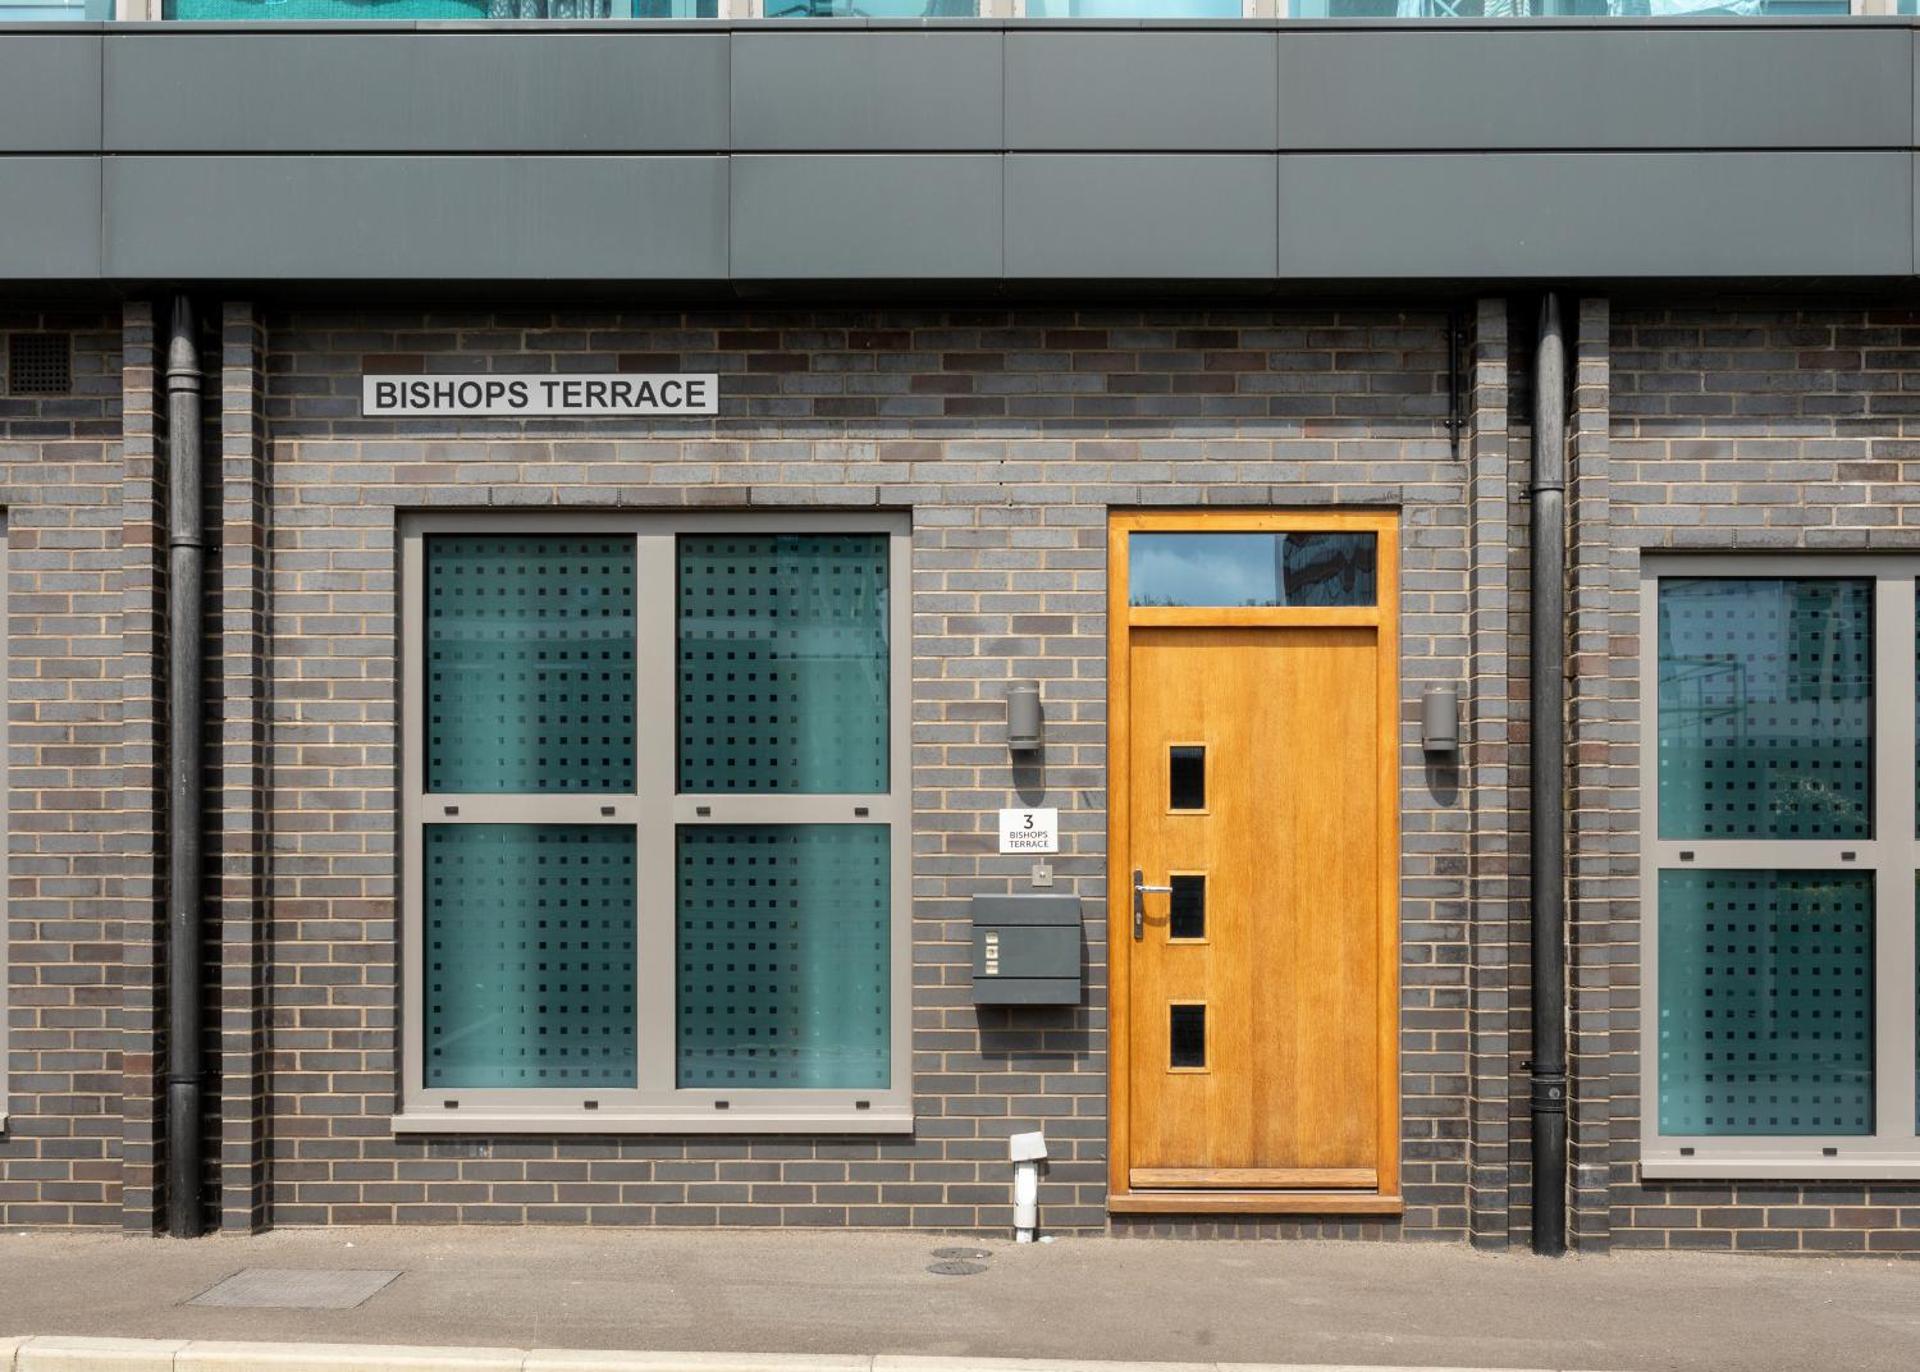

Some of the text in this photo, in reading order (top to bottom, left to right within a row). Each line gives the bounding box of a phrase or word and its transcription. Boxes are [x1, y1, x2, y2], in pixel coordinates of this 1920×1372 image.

[375, 380, 706, 409] BISHOPS TERRACE
[1023, 814, 1034, 829] 3
[1009, 831, 1048, 839] BISHOPS
[1009, 840, 1049, 848] TERRACE
